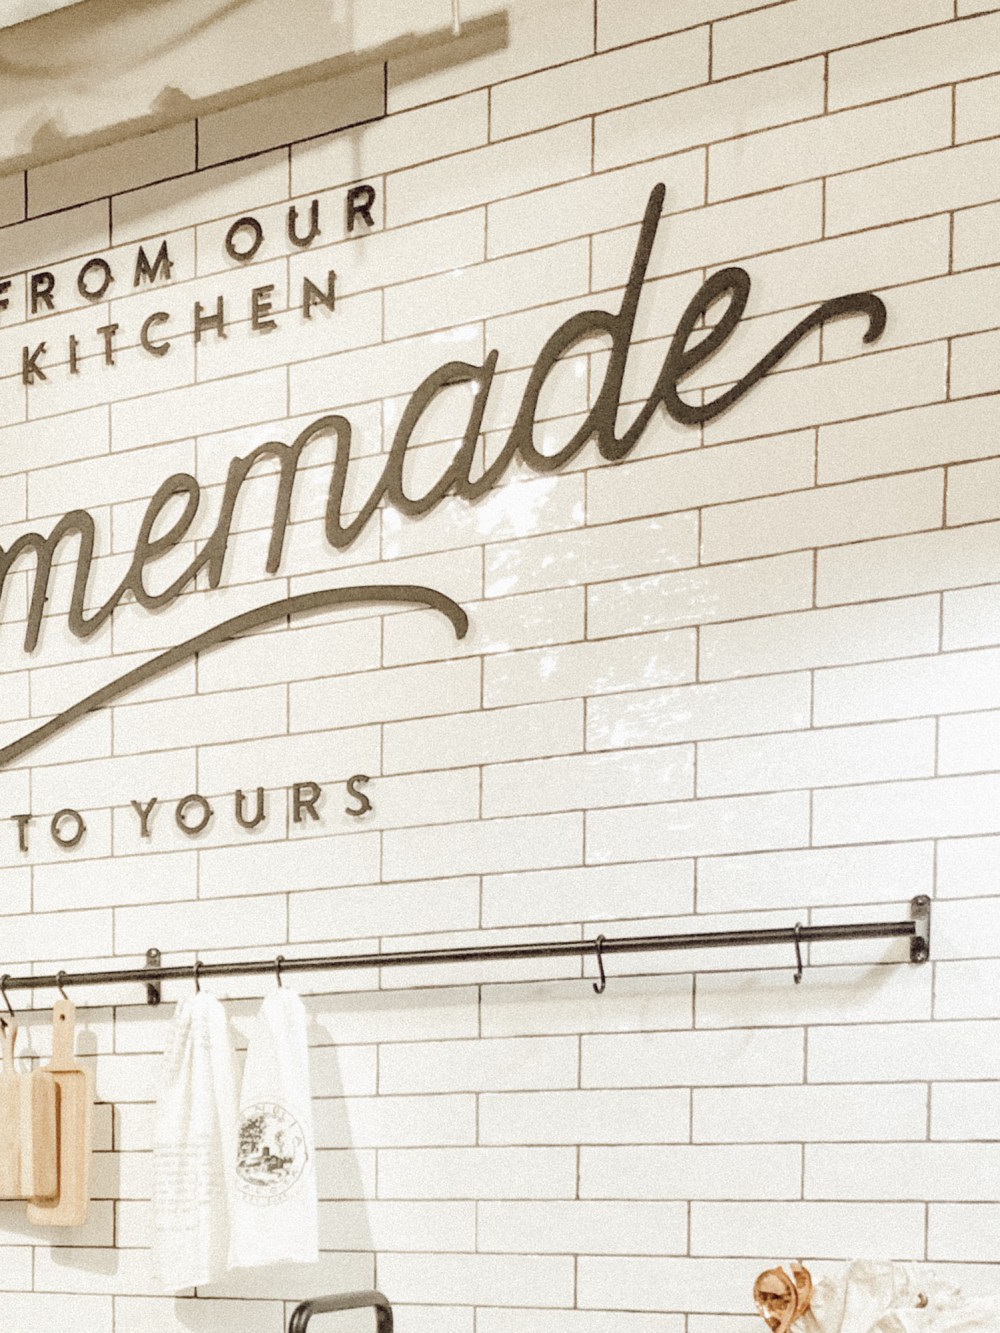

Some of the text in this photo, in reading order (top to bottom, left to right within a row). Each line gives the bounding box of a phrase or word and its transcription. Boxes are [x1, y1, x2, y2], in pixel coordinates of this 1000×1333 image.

[225, 184, 376, 262] OUR
[22, 270, 337, 386] KITCHEN
[11, 774, 373, 852] TO YOURS
